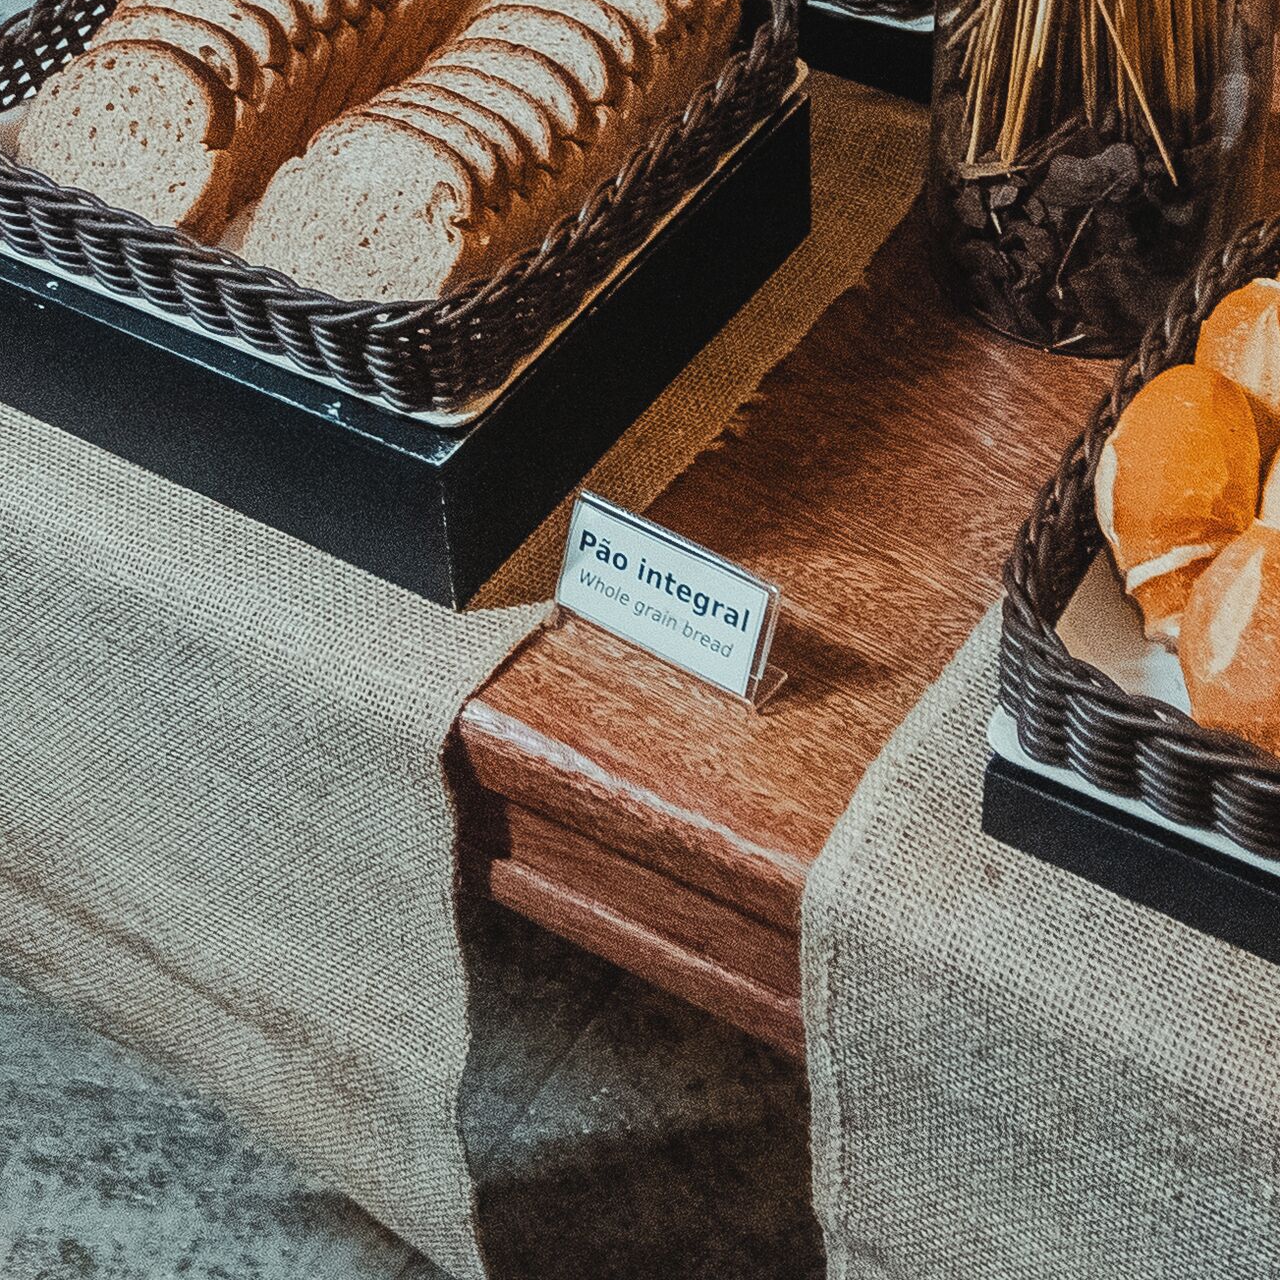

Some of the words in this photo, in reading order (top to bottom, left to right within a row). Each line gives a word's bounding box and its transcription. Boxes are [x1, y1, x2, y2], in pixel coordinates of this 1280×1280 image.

[579, 530, 628, 571] Pão
[637, 558, 750, 632] integral
[579, 568, 630, 606] Whole
[633, 600, 678, 630] grain
[682, 622, 734, 659] bread
